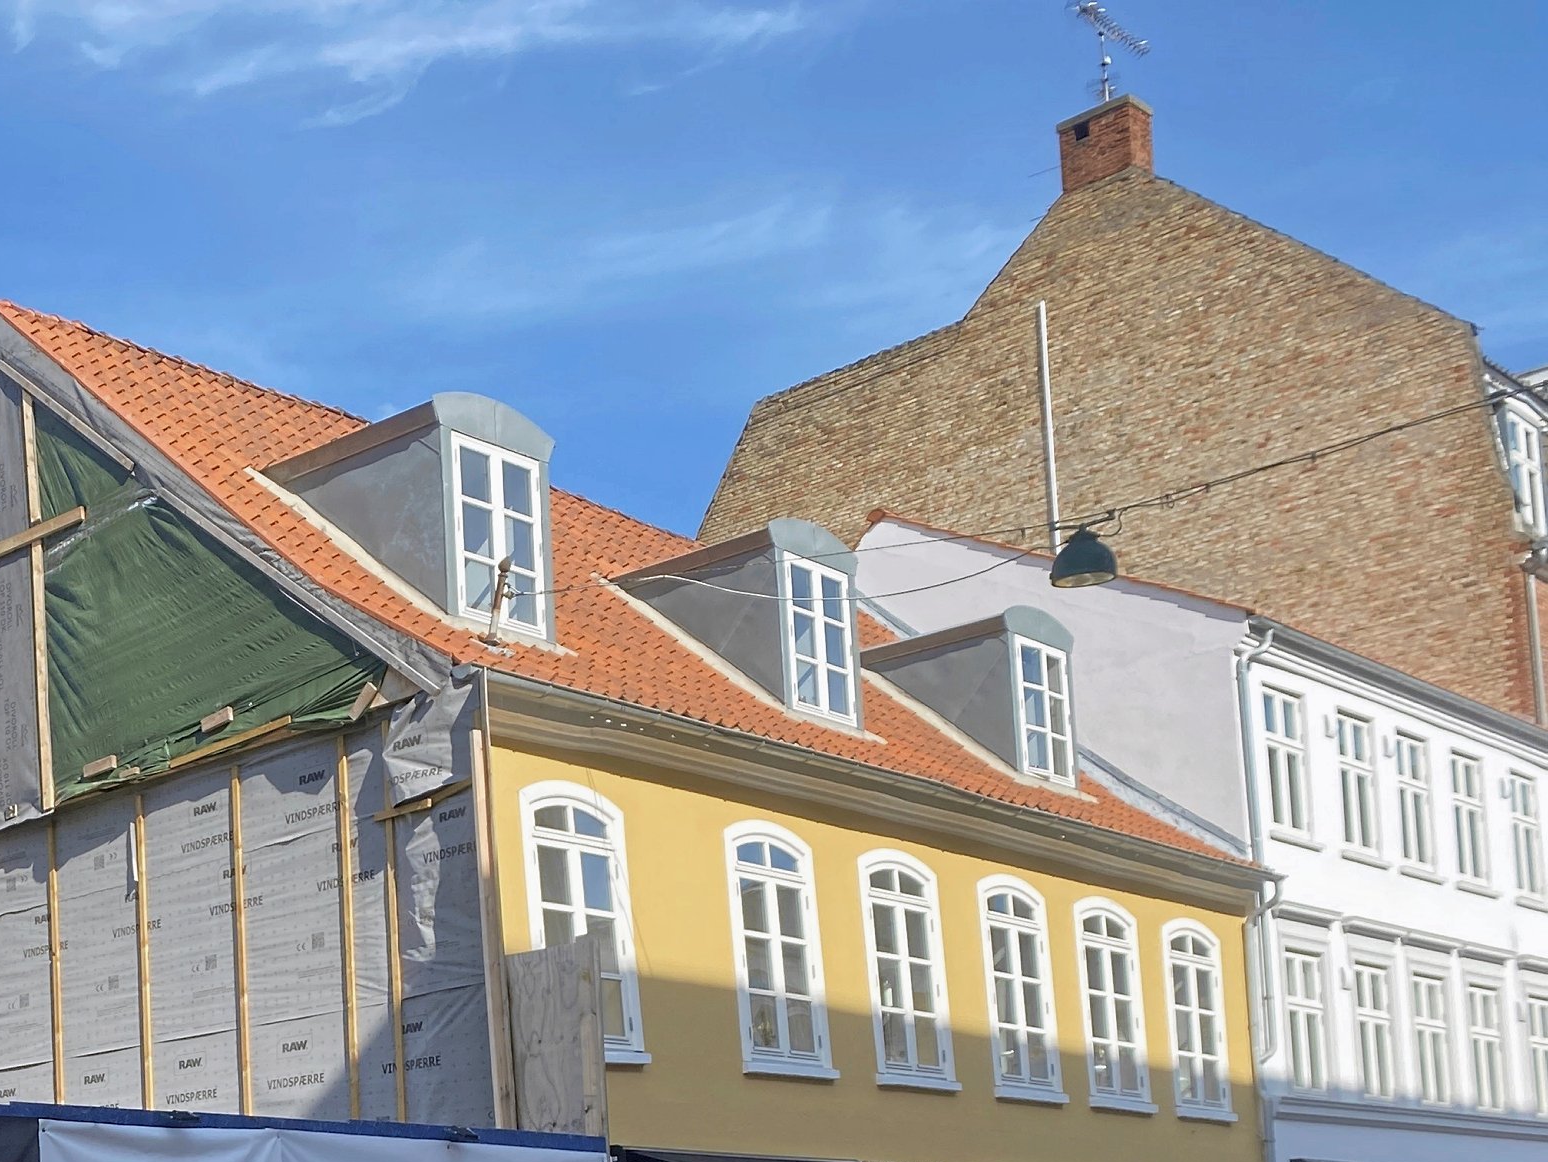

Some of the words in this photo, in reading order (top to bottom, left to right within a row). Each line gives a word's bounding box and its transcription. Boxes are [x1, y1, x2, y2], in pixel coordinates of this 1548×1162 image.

[393, 734, 423, 751] RAW
[299, 769, 325, 785] RAW
[194, 802, 217, 816] RAW
[439, 806, 466, 823] RAW
[282, 1040, 308, 1053] RAW
[179, 1057, 202, 1069] RAW
[84, 1073, 105, 1085] RAW
[267, 1072, 325, 1090] VINDSPÆRRE
[166, 1088, 217, 1105] VINDSPÆRRE
